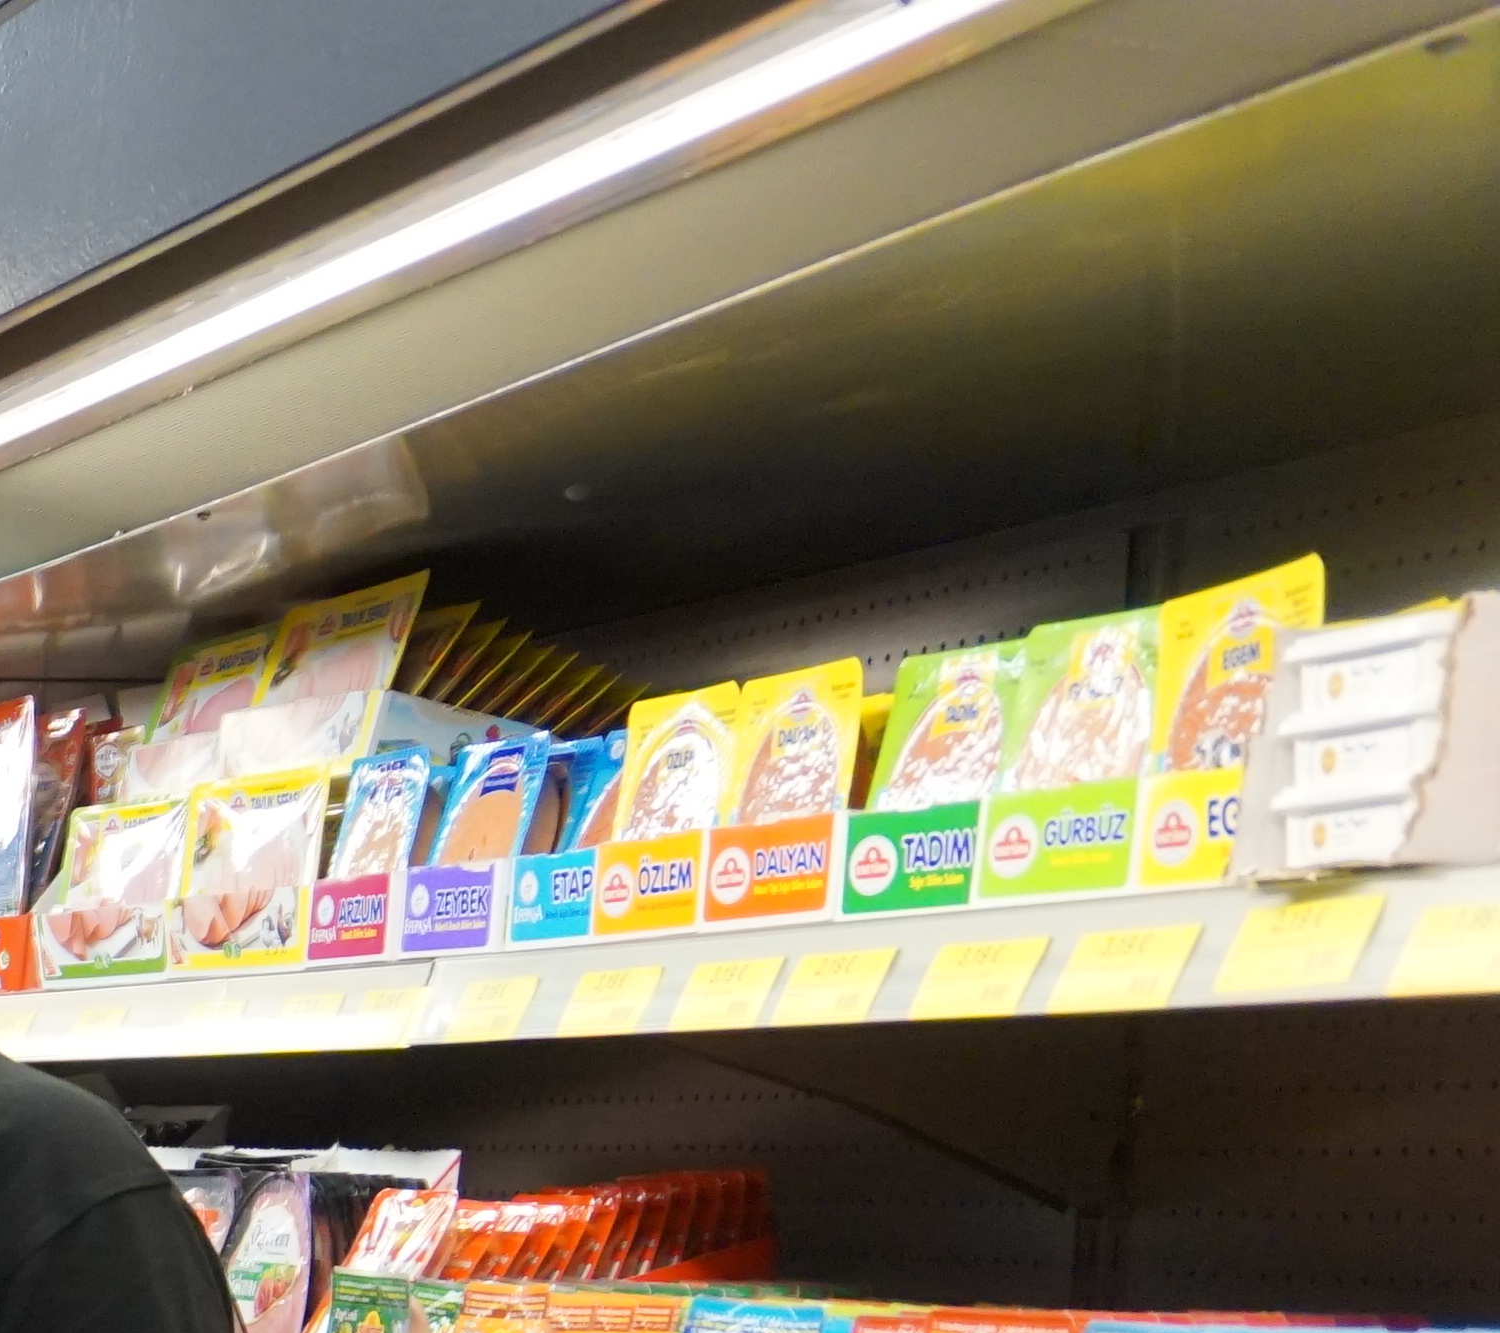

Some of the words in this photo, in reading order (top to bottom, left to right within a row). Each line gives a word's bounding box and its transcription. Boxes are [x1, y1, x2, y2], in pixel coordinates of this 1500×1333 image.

[1044, 808, 1128, 848] GÜRBÜZ
[754, 844, 826, 880] DALYAN
[903, 829, 974, 871] TADIM
[552, 868, 594, 902] ETAP
[637, 859, 694, 896] ÖZLEM
[338, 895, 386, 927] ARZUM
[434, 887, 490, 918] ZEYBEK
